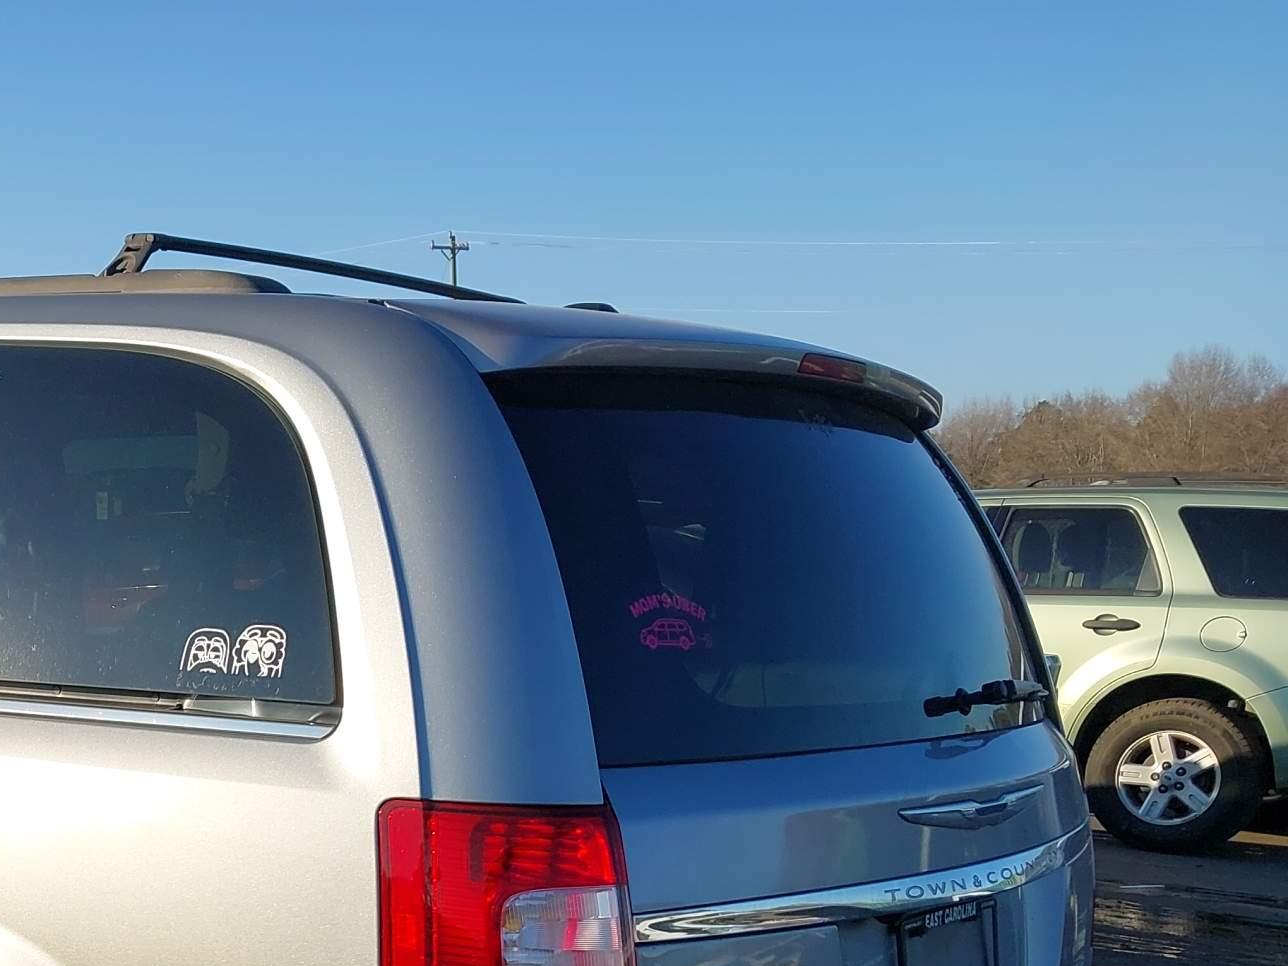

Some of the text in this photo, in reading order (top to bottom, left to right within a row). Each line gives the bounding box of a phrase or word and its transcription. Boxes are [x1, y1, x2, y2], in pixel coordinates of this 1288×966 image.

[884, 850, 1058, 903] TOWN & COUN
[925, 901, 977, 928] EAST CAROLINA
